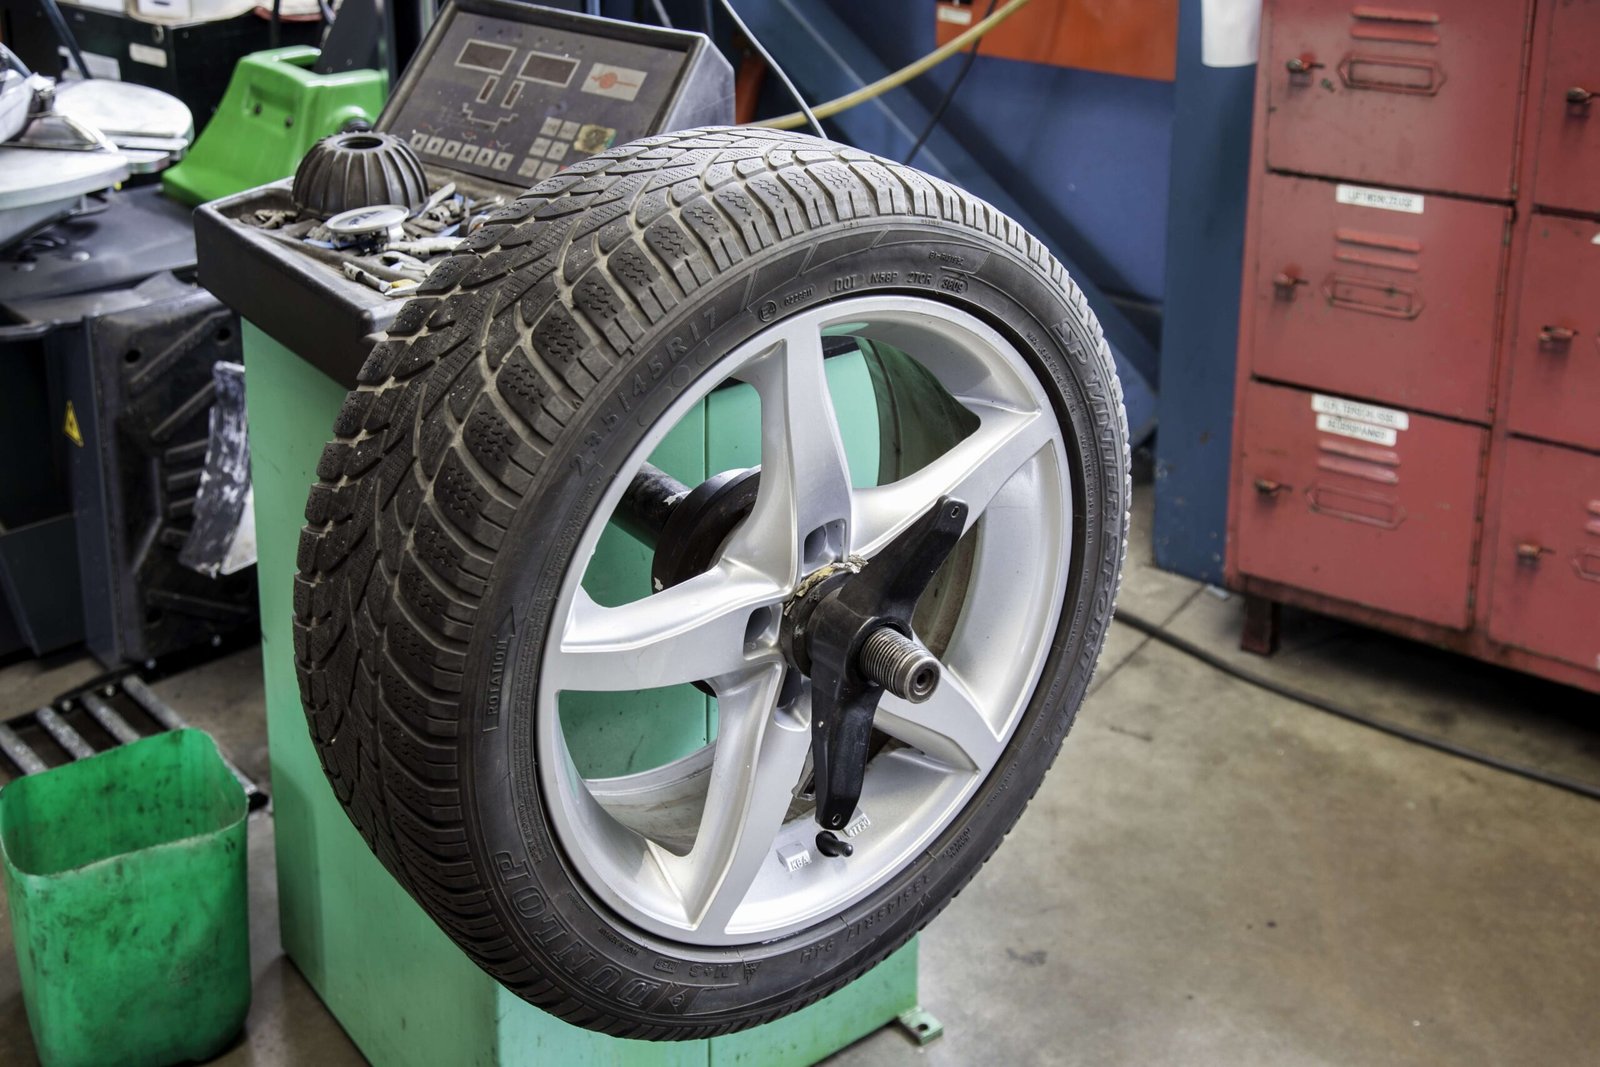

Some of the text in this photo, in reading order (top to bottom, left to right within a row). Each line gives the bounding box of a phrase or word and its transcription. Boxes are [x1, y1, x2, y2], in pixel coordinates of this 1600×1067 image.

[834, 276, 856, 292] DOT
[1051, 320, 1088, 365] SP
[1083, 370, 1119, 522] WINTER
[1079, 530, 1118, 682] SPORT
[487, 640, 508, 715] ROTATION
[494, 850, 661, 1007] DUNLOP
